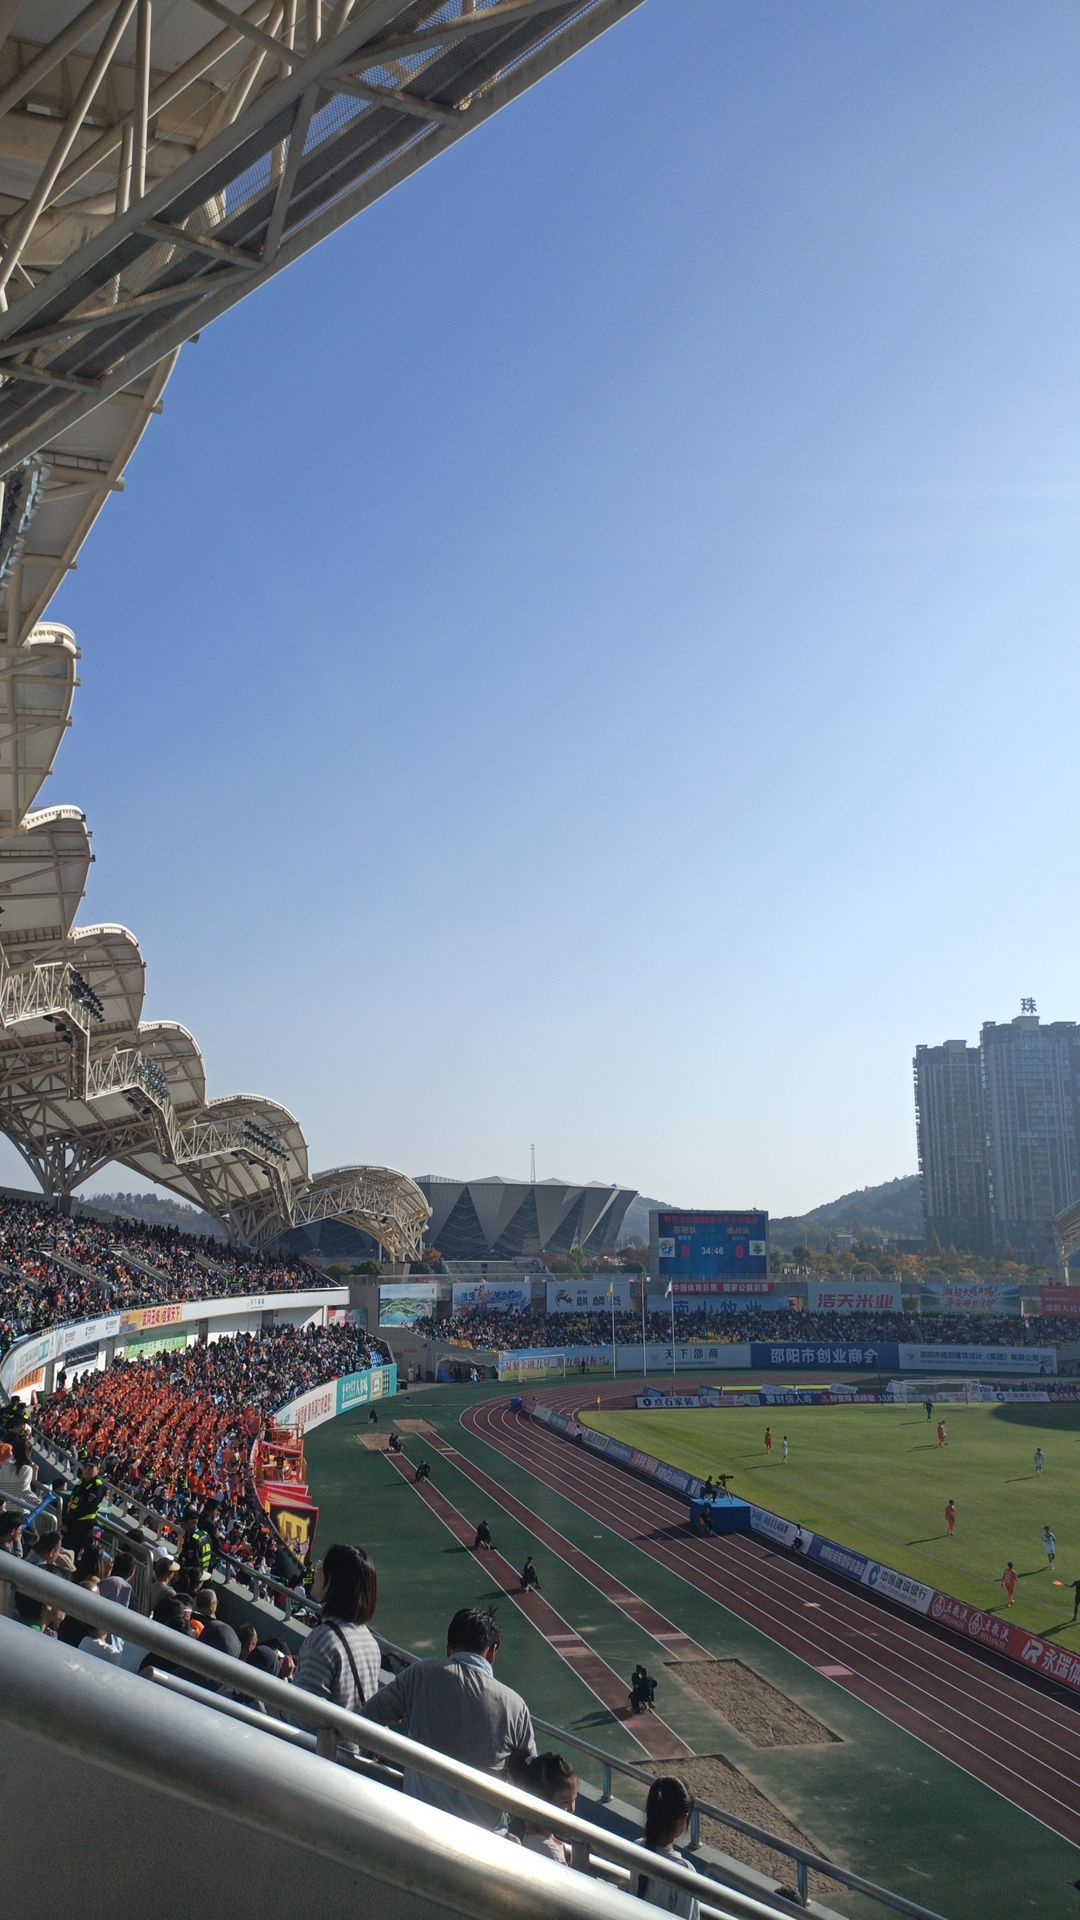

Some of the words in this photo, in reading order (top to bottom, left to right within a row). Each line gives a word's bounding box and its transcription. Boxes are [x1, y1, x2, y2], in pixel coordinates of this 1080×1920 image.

[1020, 997, 1037, 1013] 珠
[701, 1246, 724, 1255] 34:46
[817, 1294, 894, 1309] 浩天米业
[770, 1348, 879, 1364] 邵阳市创业商会
[880, 1571, 928, 1600] 中国建设银行
